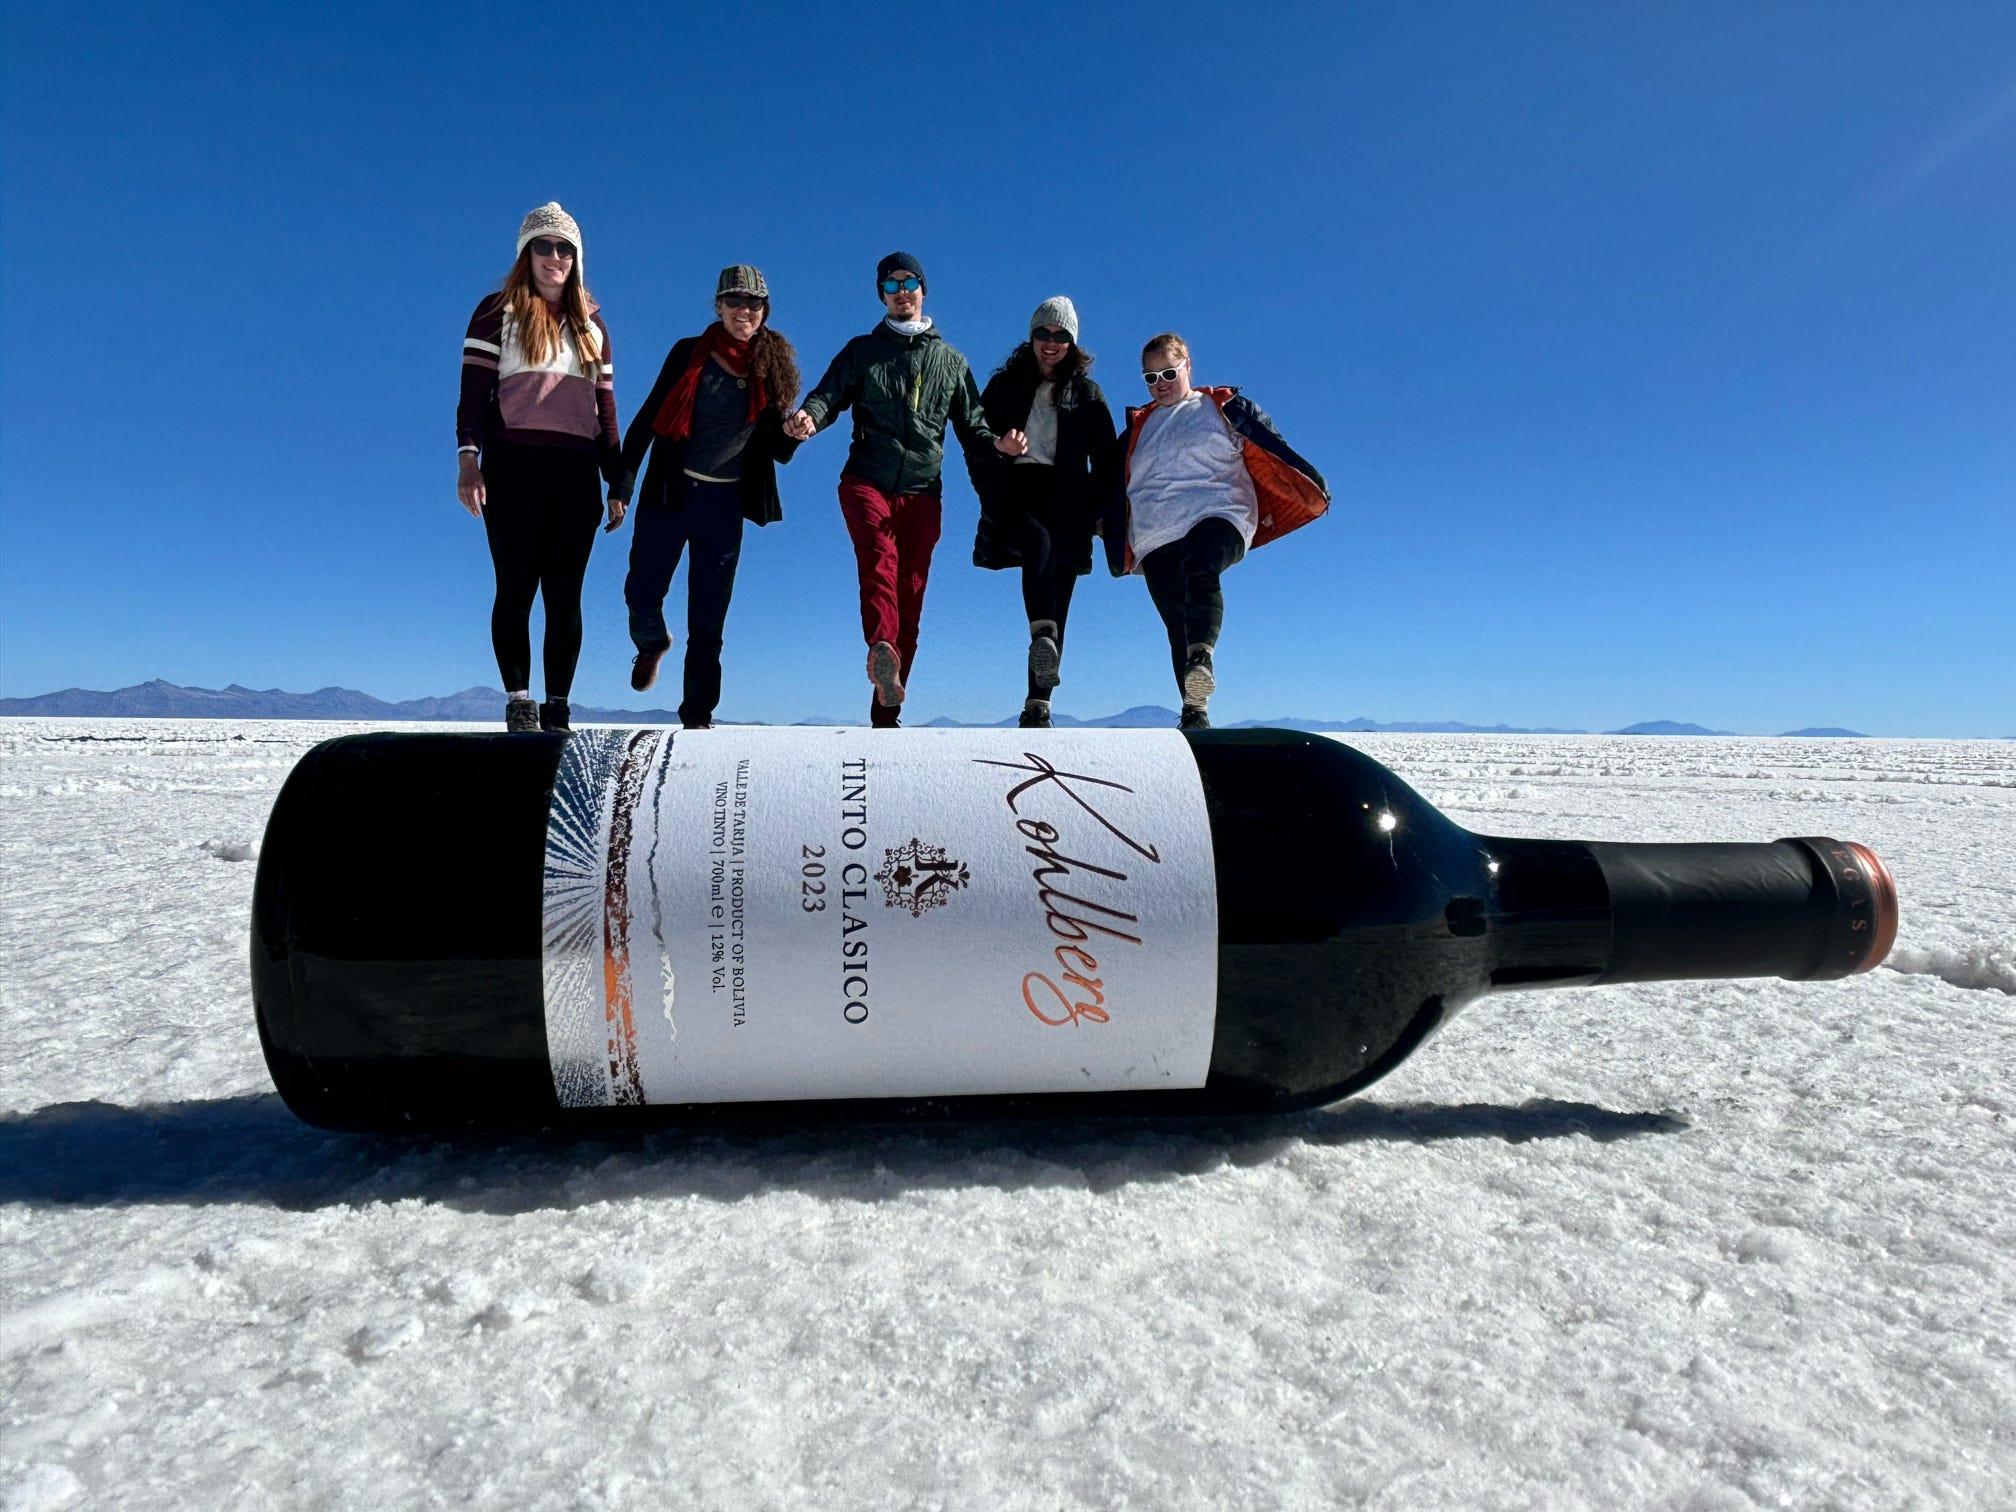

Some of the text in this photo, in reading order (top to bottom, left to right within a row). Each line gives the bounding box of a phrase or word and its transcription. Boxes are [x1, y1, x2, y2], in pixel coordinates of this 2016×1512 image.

[715, 781, 728, 808] VINO
[735, 759, 750, 790] VALLE
[734, 791, 747, 808] DE
[713, 808, 726, 847] TINTO
[730, 809, 746, 857] TARIJA
[711, 860, 725, 901] 700ml
[802, 844, 826, 913] 2023
[842, 758, 869, 1025] TINTO CLASICO
[971, 752, 1161, 1028] Kohlberg
[731, 867, 745, 940] PRODUCT
[711, 934, 725, 963] 12%
[731, 943, 745, 964] OF
[712, 966, 726, 993] Vol.
[732, 967, 746, 1028] BOLIVIA
